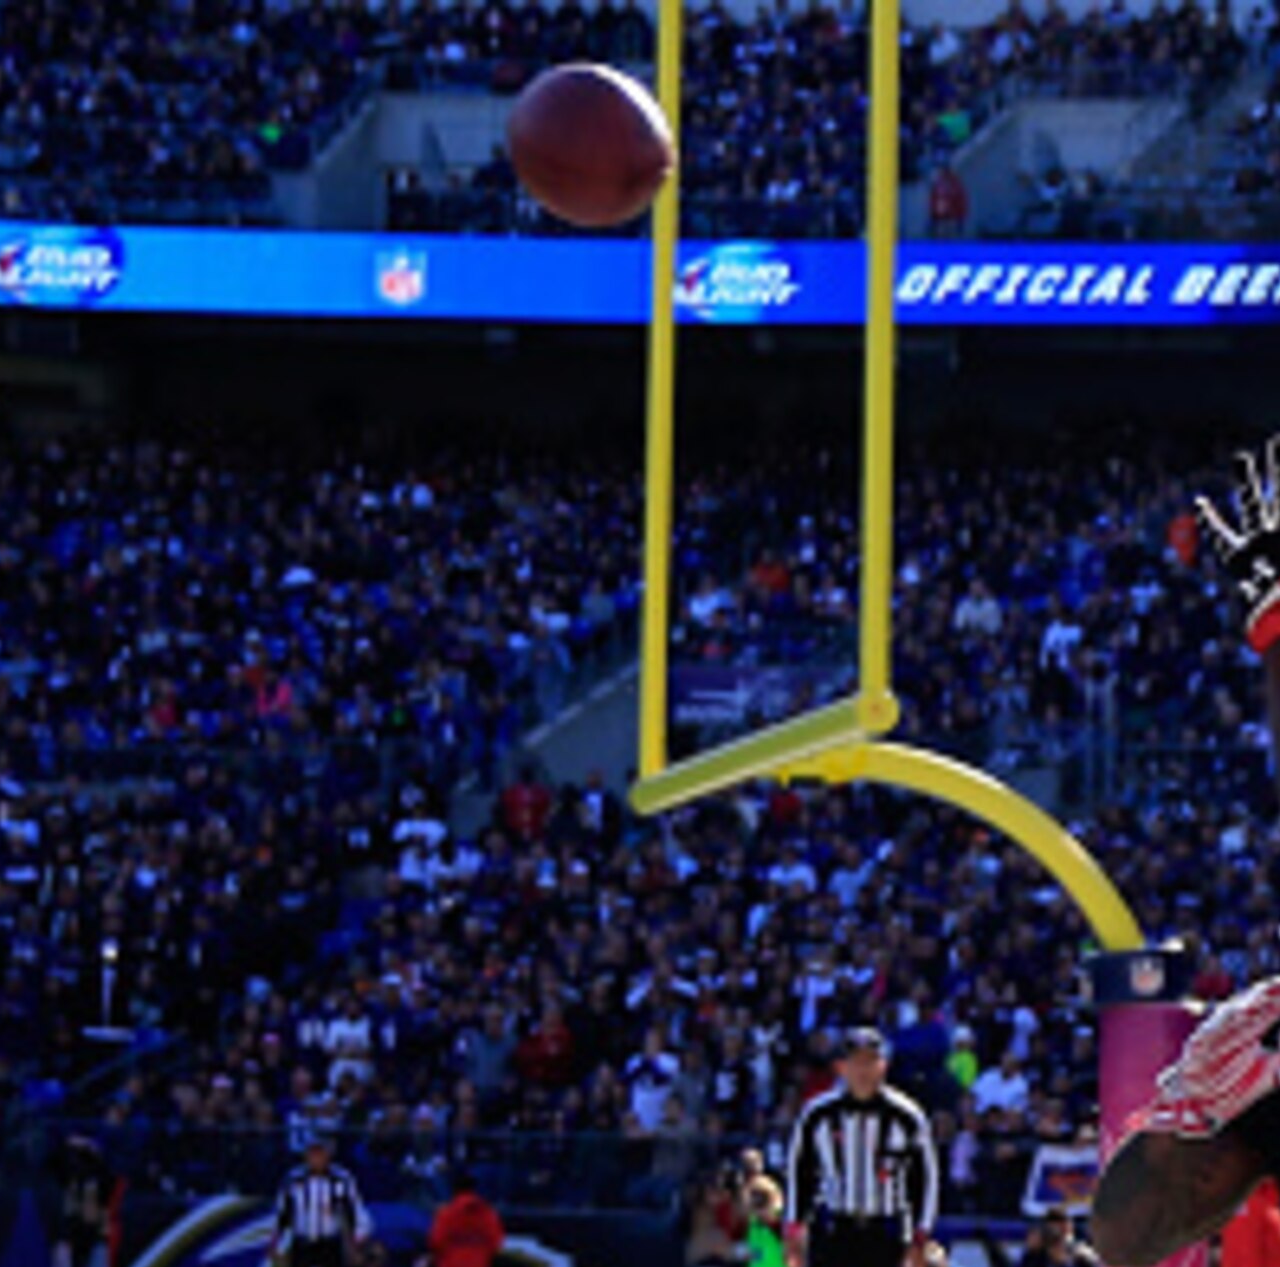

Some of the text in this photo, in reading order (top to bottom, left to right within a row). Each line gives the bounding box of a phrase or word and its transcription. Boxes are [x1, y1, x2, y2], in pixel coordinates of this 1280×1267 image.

[25, 244, 111, 268] BUD
[710, 259, 790, 285] BUD
[896, 262, 1153, 306] OFFICIAL
